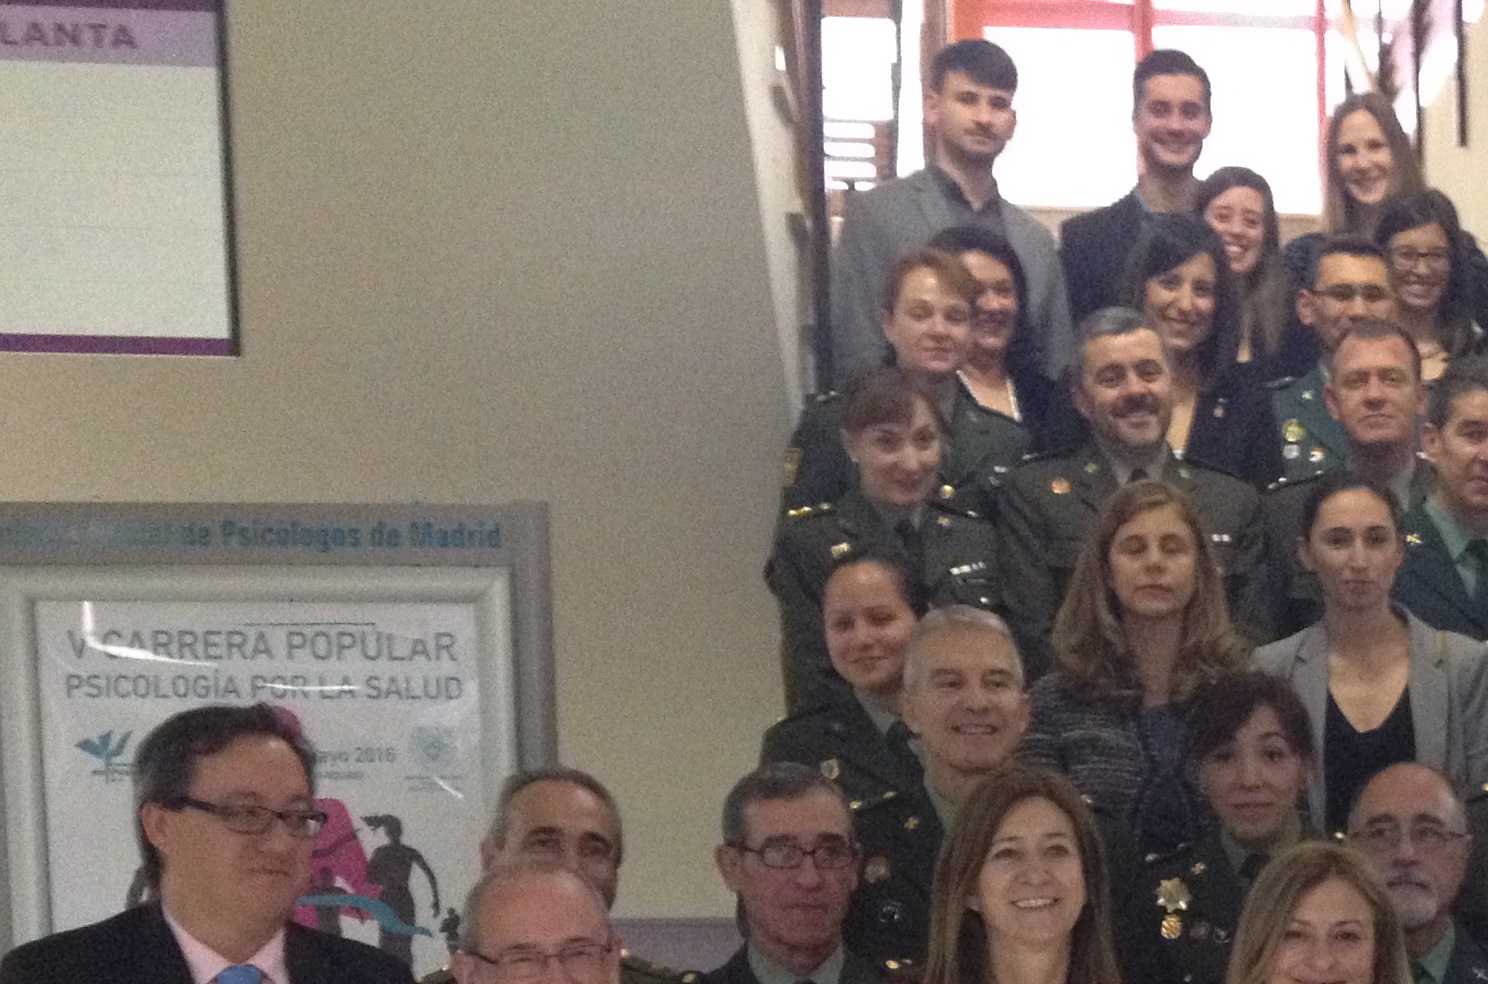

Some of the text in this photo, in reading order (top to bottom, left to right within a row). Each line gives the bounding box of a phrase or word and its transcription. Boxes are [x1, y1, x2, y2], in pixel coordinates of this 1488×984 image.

[410, 520, 501, 548] Madrid
[102, 630, 275, 661] CARRERA
[286, 630, 457, 662] POPULAR
[66, 668, 462, 700] PSICOLOGÍA POR LA SALUD
